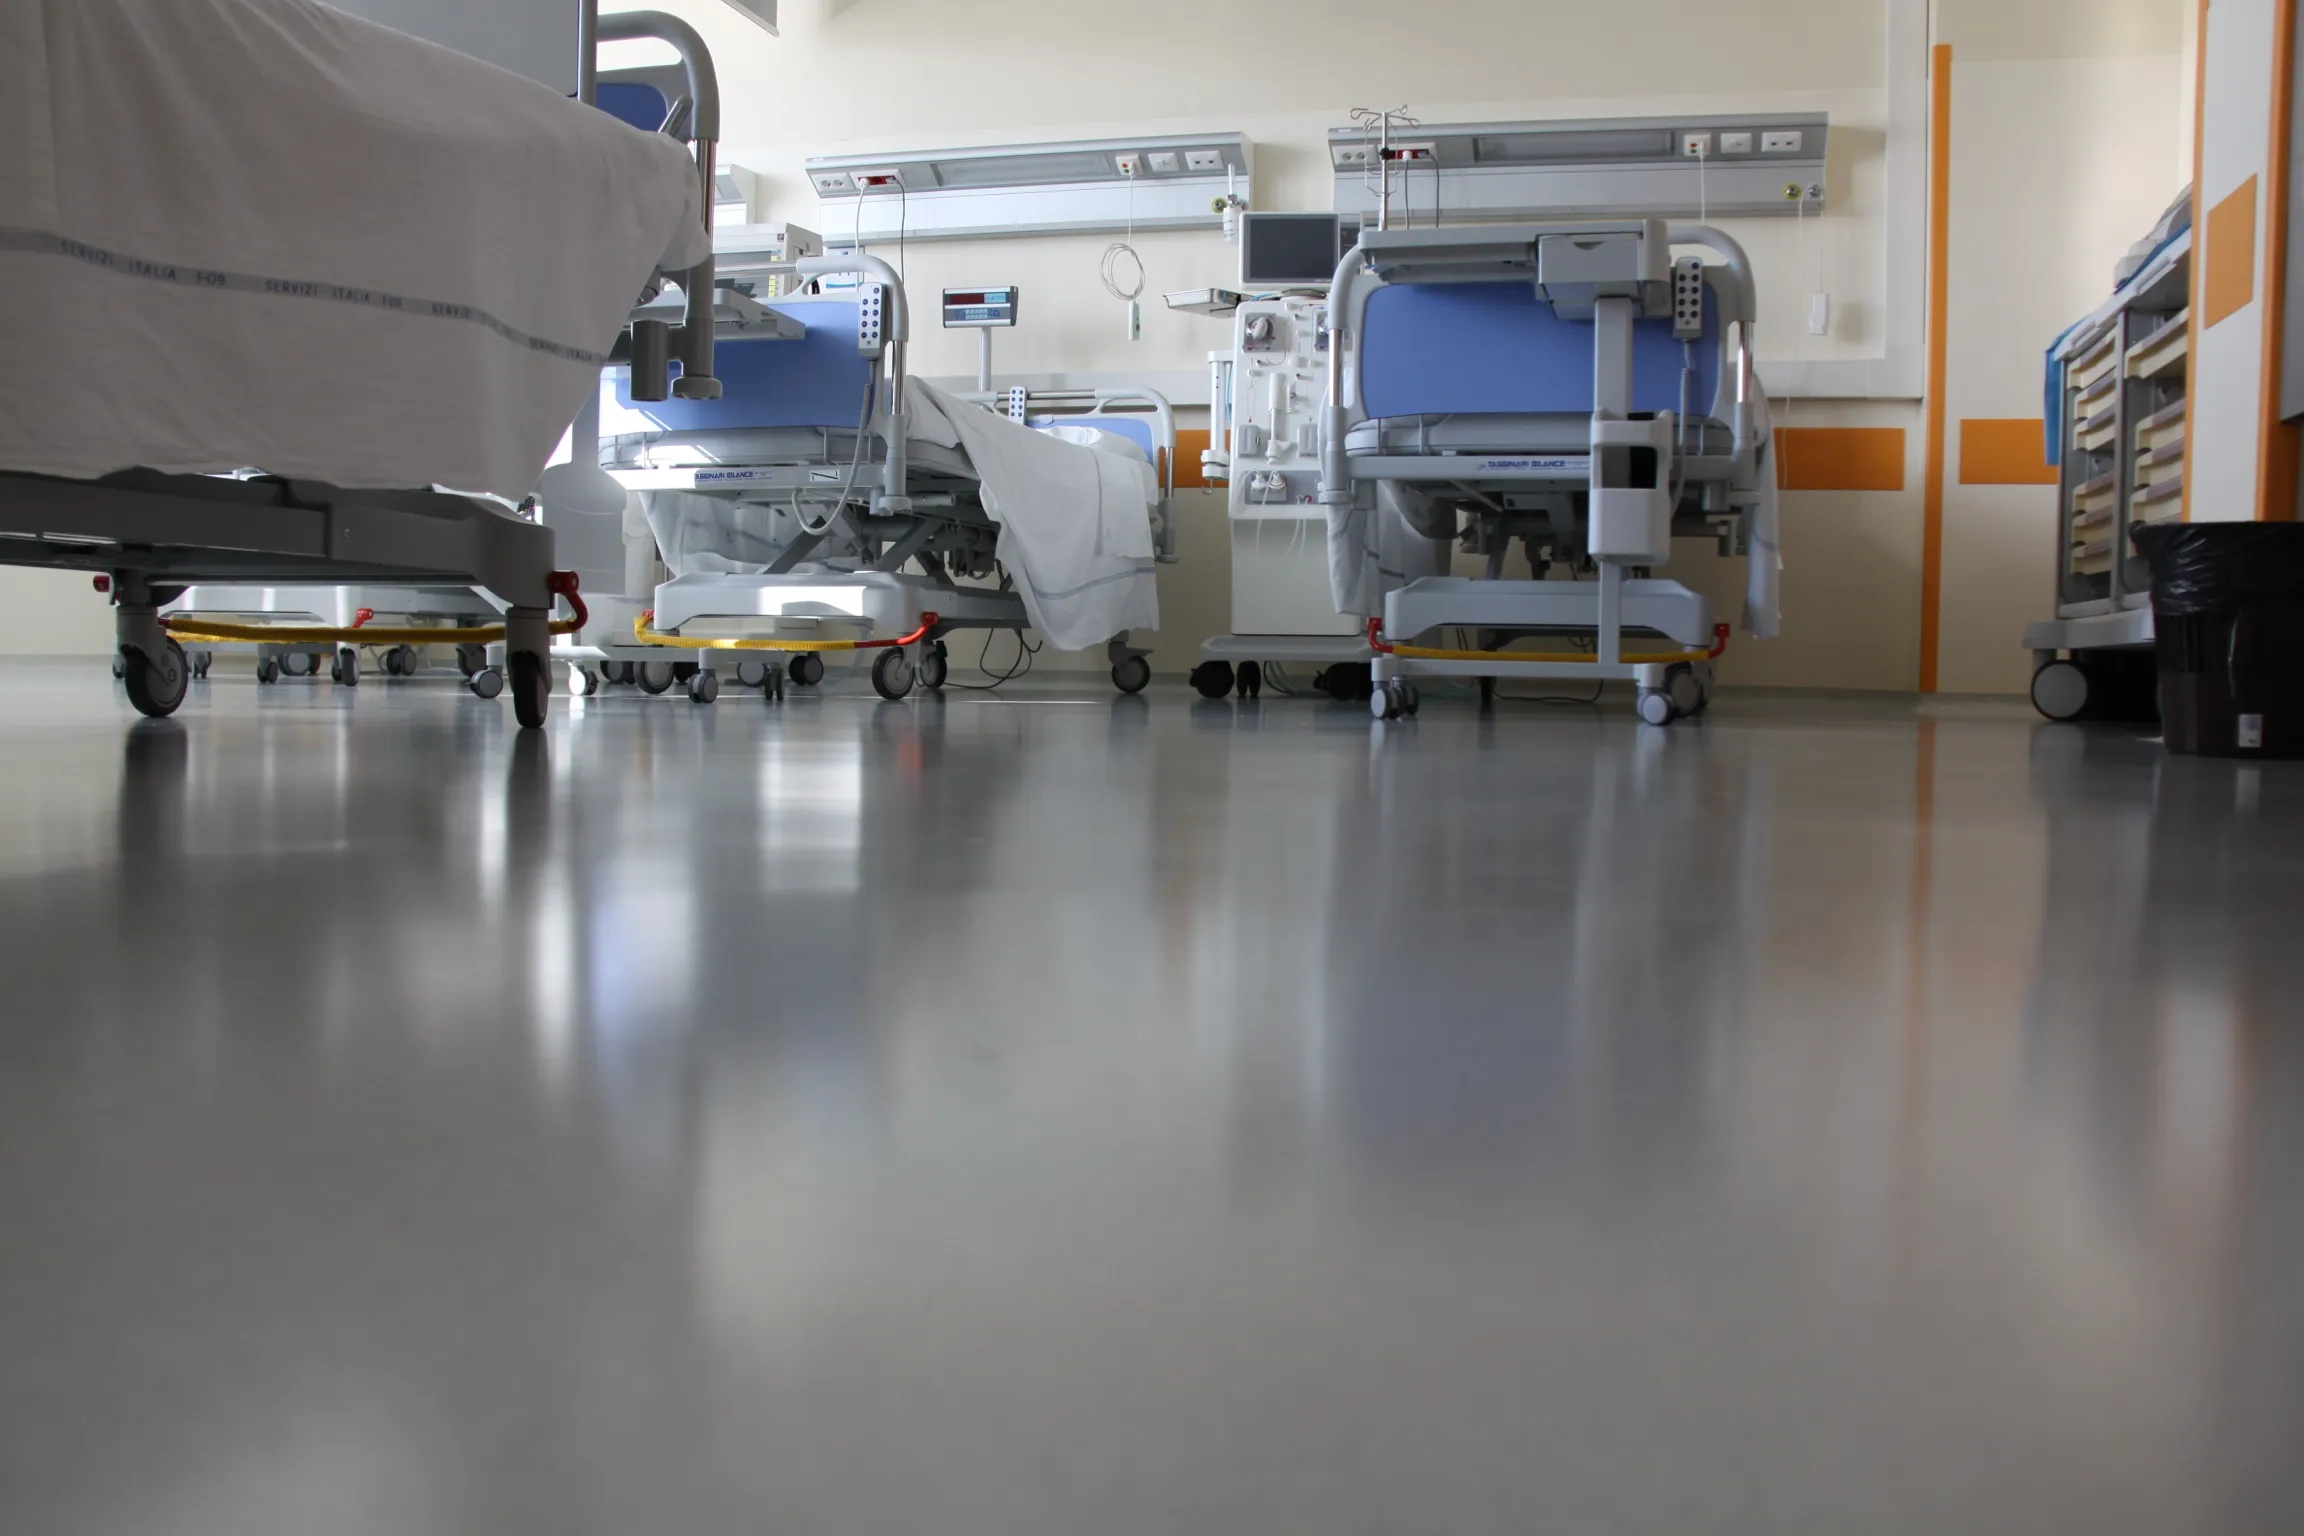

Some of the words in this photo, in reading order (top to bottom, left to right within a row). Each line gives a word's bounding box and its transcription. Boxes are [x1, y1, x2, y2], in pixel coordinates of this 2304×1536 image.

[60, 239, 114, 266] SERVIZI
[129, 259, 177, 280] ITALIA
[265, 280, 318, 297] SERVIZI
[332, 287, 370, 302] ITALIA
[1531, 460, 1566, 468] BILANCE
[694, 472, 725, 480] ASSINARI
[726, 471, 754, 479] BILANCE
